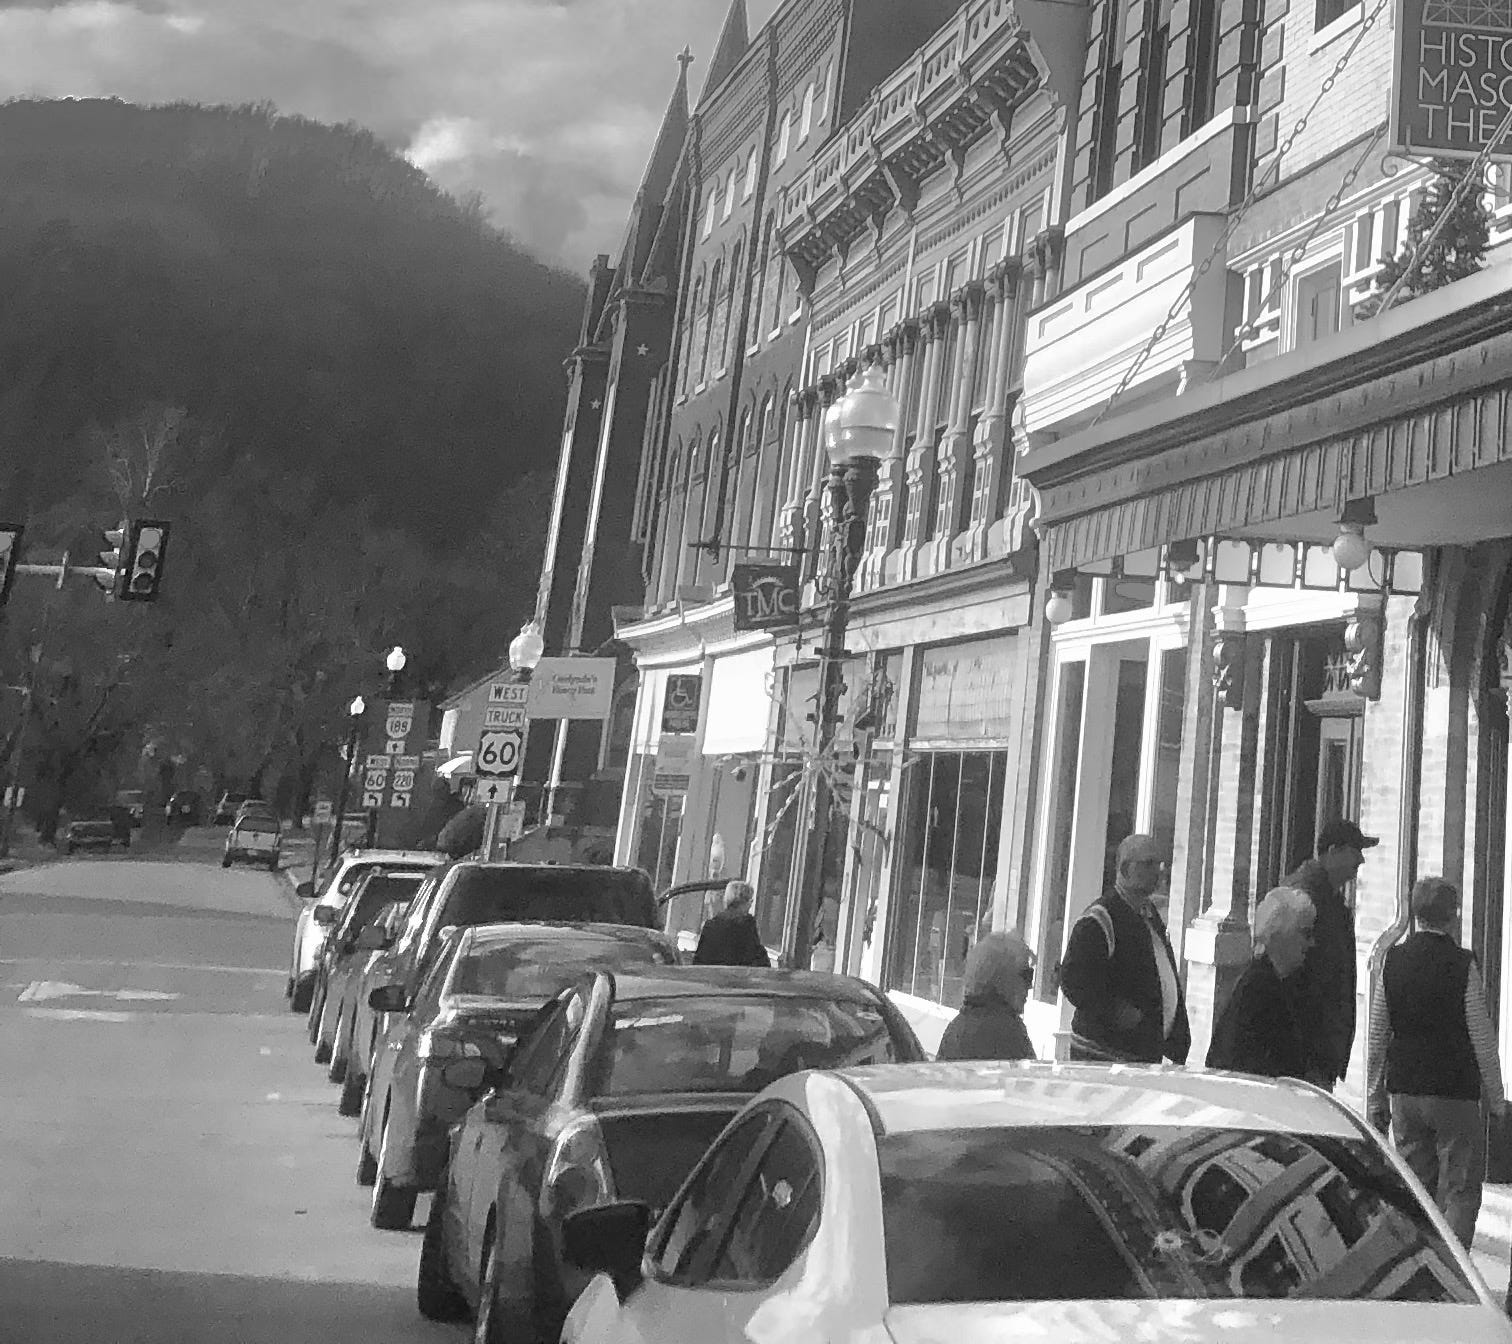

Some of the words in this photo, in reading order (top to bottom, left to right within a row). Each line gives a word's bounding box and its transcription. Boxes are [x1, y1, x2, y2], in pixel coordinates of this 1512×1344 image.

[741, 587, 794, 618] TMC
[494, 685, 525, 700] WEST
[488, 710, 523, 723] TRUCK
[482, 741, 516, 765] 60
[367, 774, 384, 787] 60
